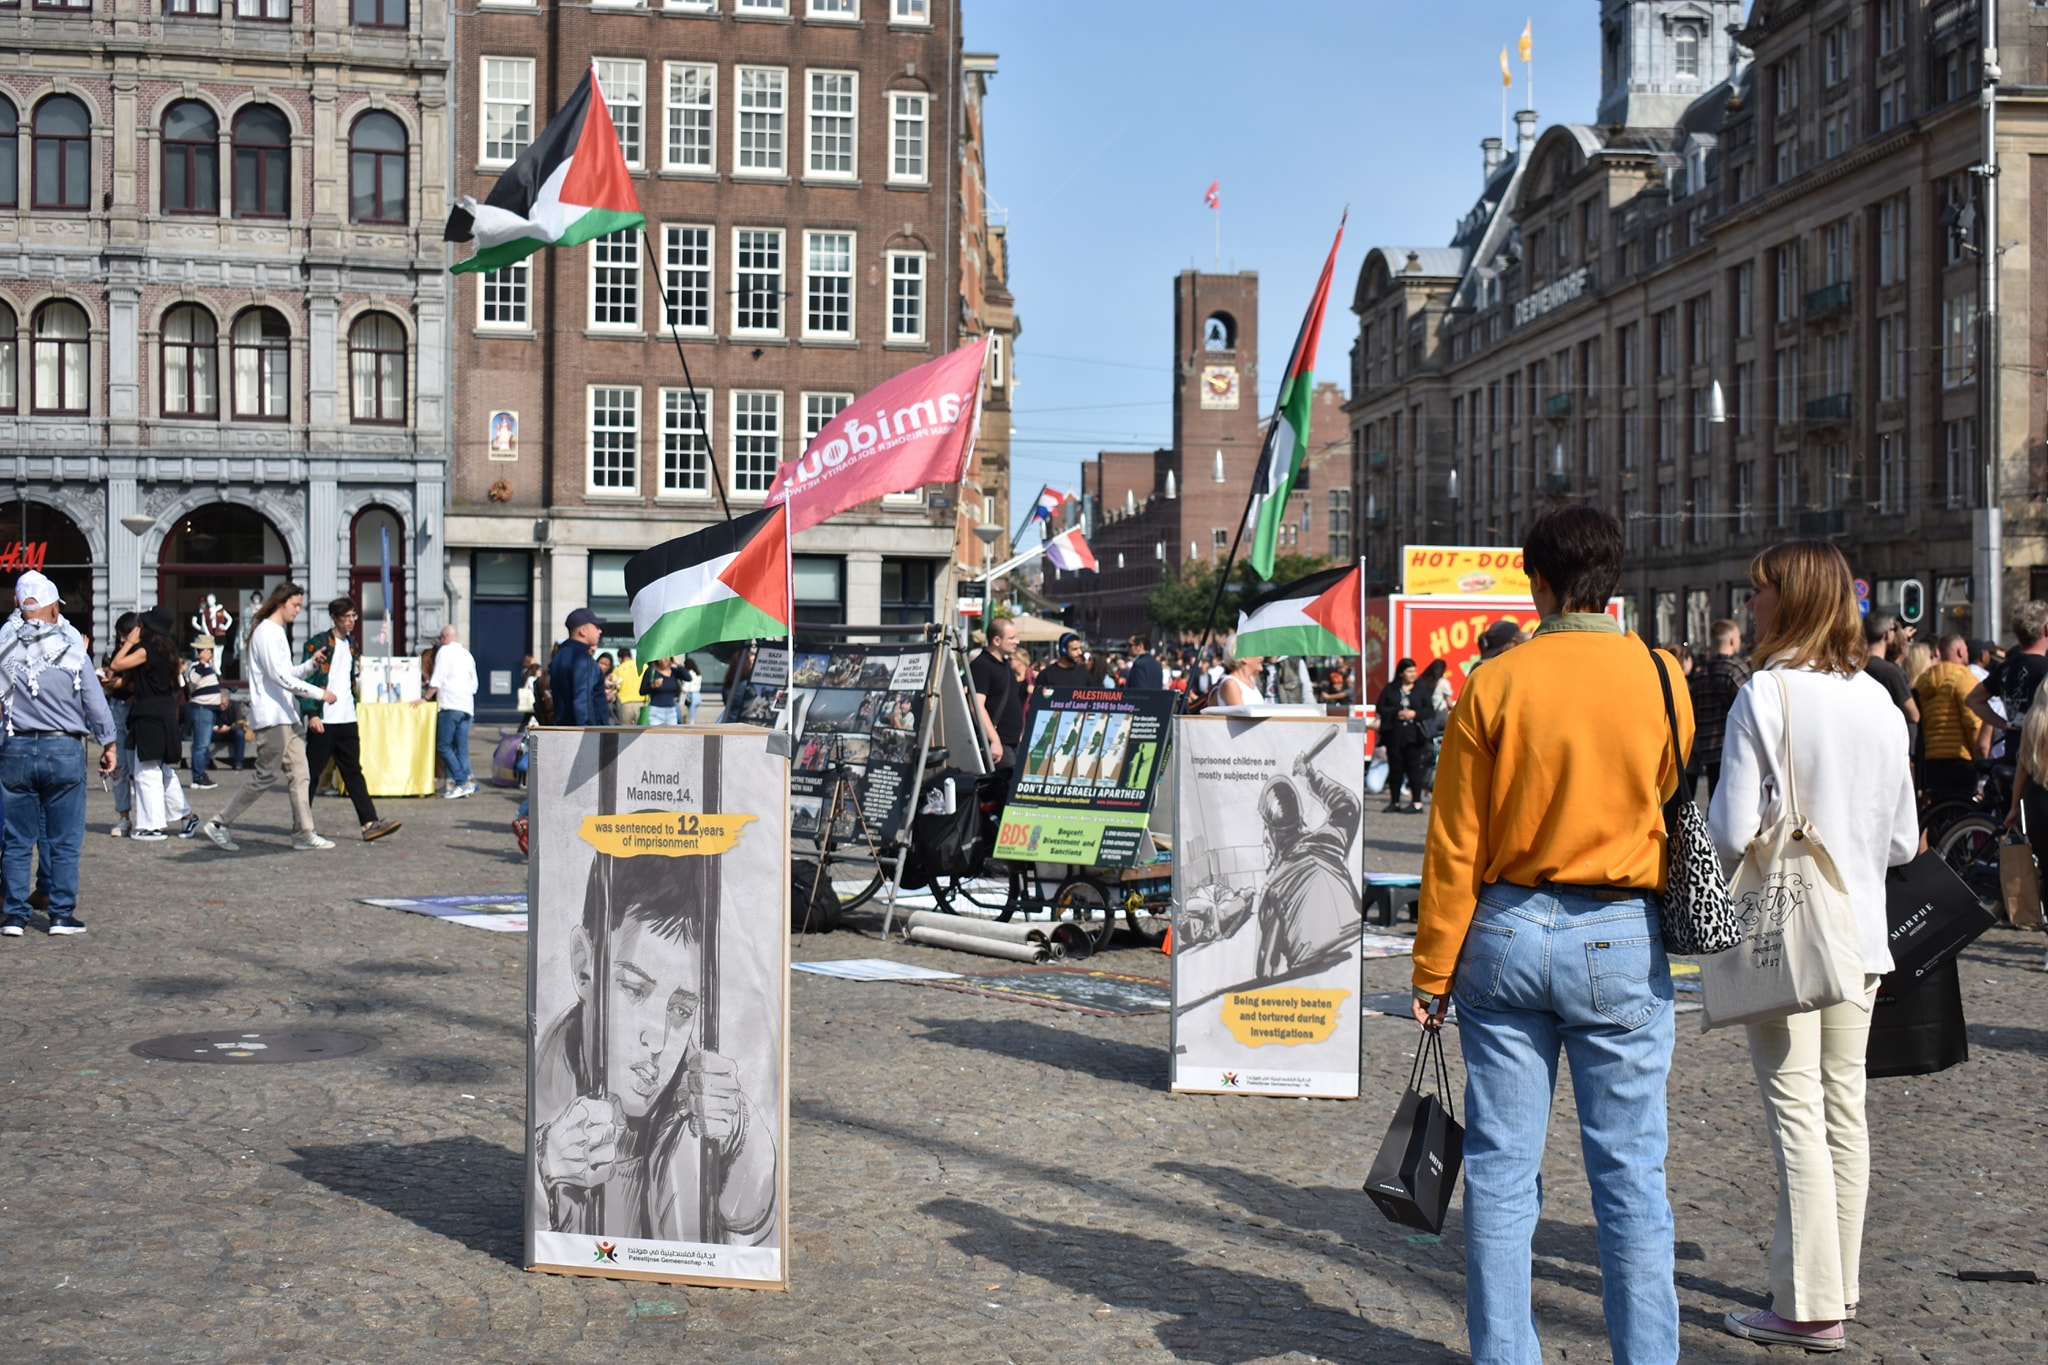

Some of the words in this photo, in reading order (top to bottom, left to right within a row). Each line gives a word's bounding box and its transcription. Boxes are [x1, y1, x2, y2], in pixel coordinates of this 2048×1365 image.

[1072, 690, 1123, 701] PALESTINIAN
[1050, 700, 1063, 709] Loss
[1072, 702, 1088, 710] Land
[1092, 702, 1109, 710] 1946
[1110, 702, 1116, 710] to
[1191, 756, 1232, 767] Imprisoned
[1232, 756, 1262, 767] children
[1264, 759, 1276, 767] are
[641, 770, 680, 785] Ahmad
[1198, 770, 1222, 782] mostly
[1224, 771, 1260, 782] subjected
[1260, 772, 1269, 781] to
[1017, 783, 1043, 795] DON'T
[1044, 784, 1062, 796] BUY
[1063, 785, 1097, 798] ISRAELI
[1098, 786, 1146, 800] APARTHEID
[595, 823, 613, 833] was
[614, 824, 662, 835] sentenced
[665, 825, 674, 835] to
[678, 815, 700, 836] 12
[699, 826, 725, 840] years
[1000, 823, 1030, 847] BDS
[622, 835, 632, 846] of
[634, 836, 699, 849] imprisonment
[1042, 837, 1080, 847] Divestment
[1082, 840, 1096, 848] and
[1050, 848, 1082, 857] Sanctions
[1890, 902, 1934, 940] MORPHE
[1234, 996, 1259, 1008] Being
[1261, 997, 1299, 1009] severely
[1300, 998, 1332, 1008] beaten
[1240, 1012, 1256, 1021] and
[1258, 1012, 1295, 1023] tortured
[1296, 1014, 1326, 1026] during
[628, 1255, 660, 1263] Palestijnse
[661, 1257, 702, 1266] Gemeenschap
